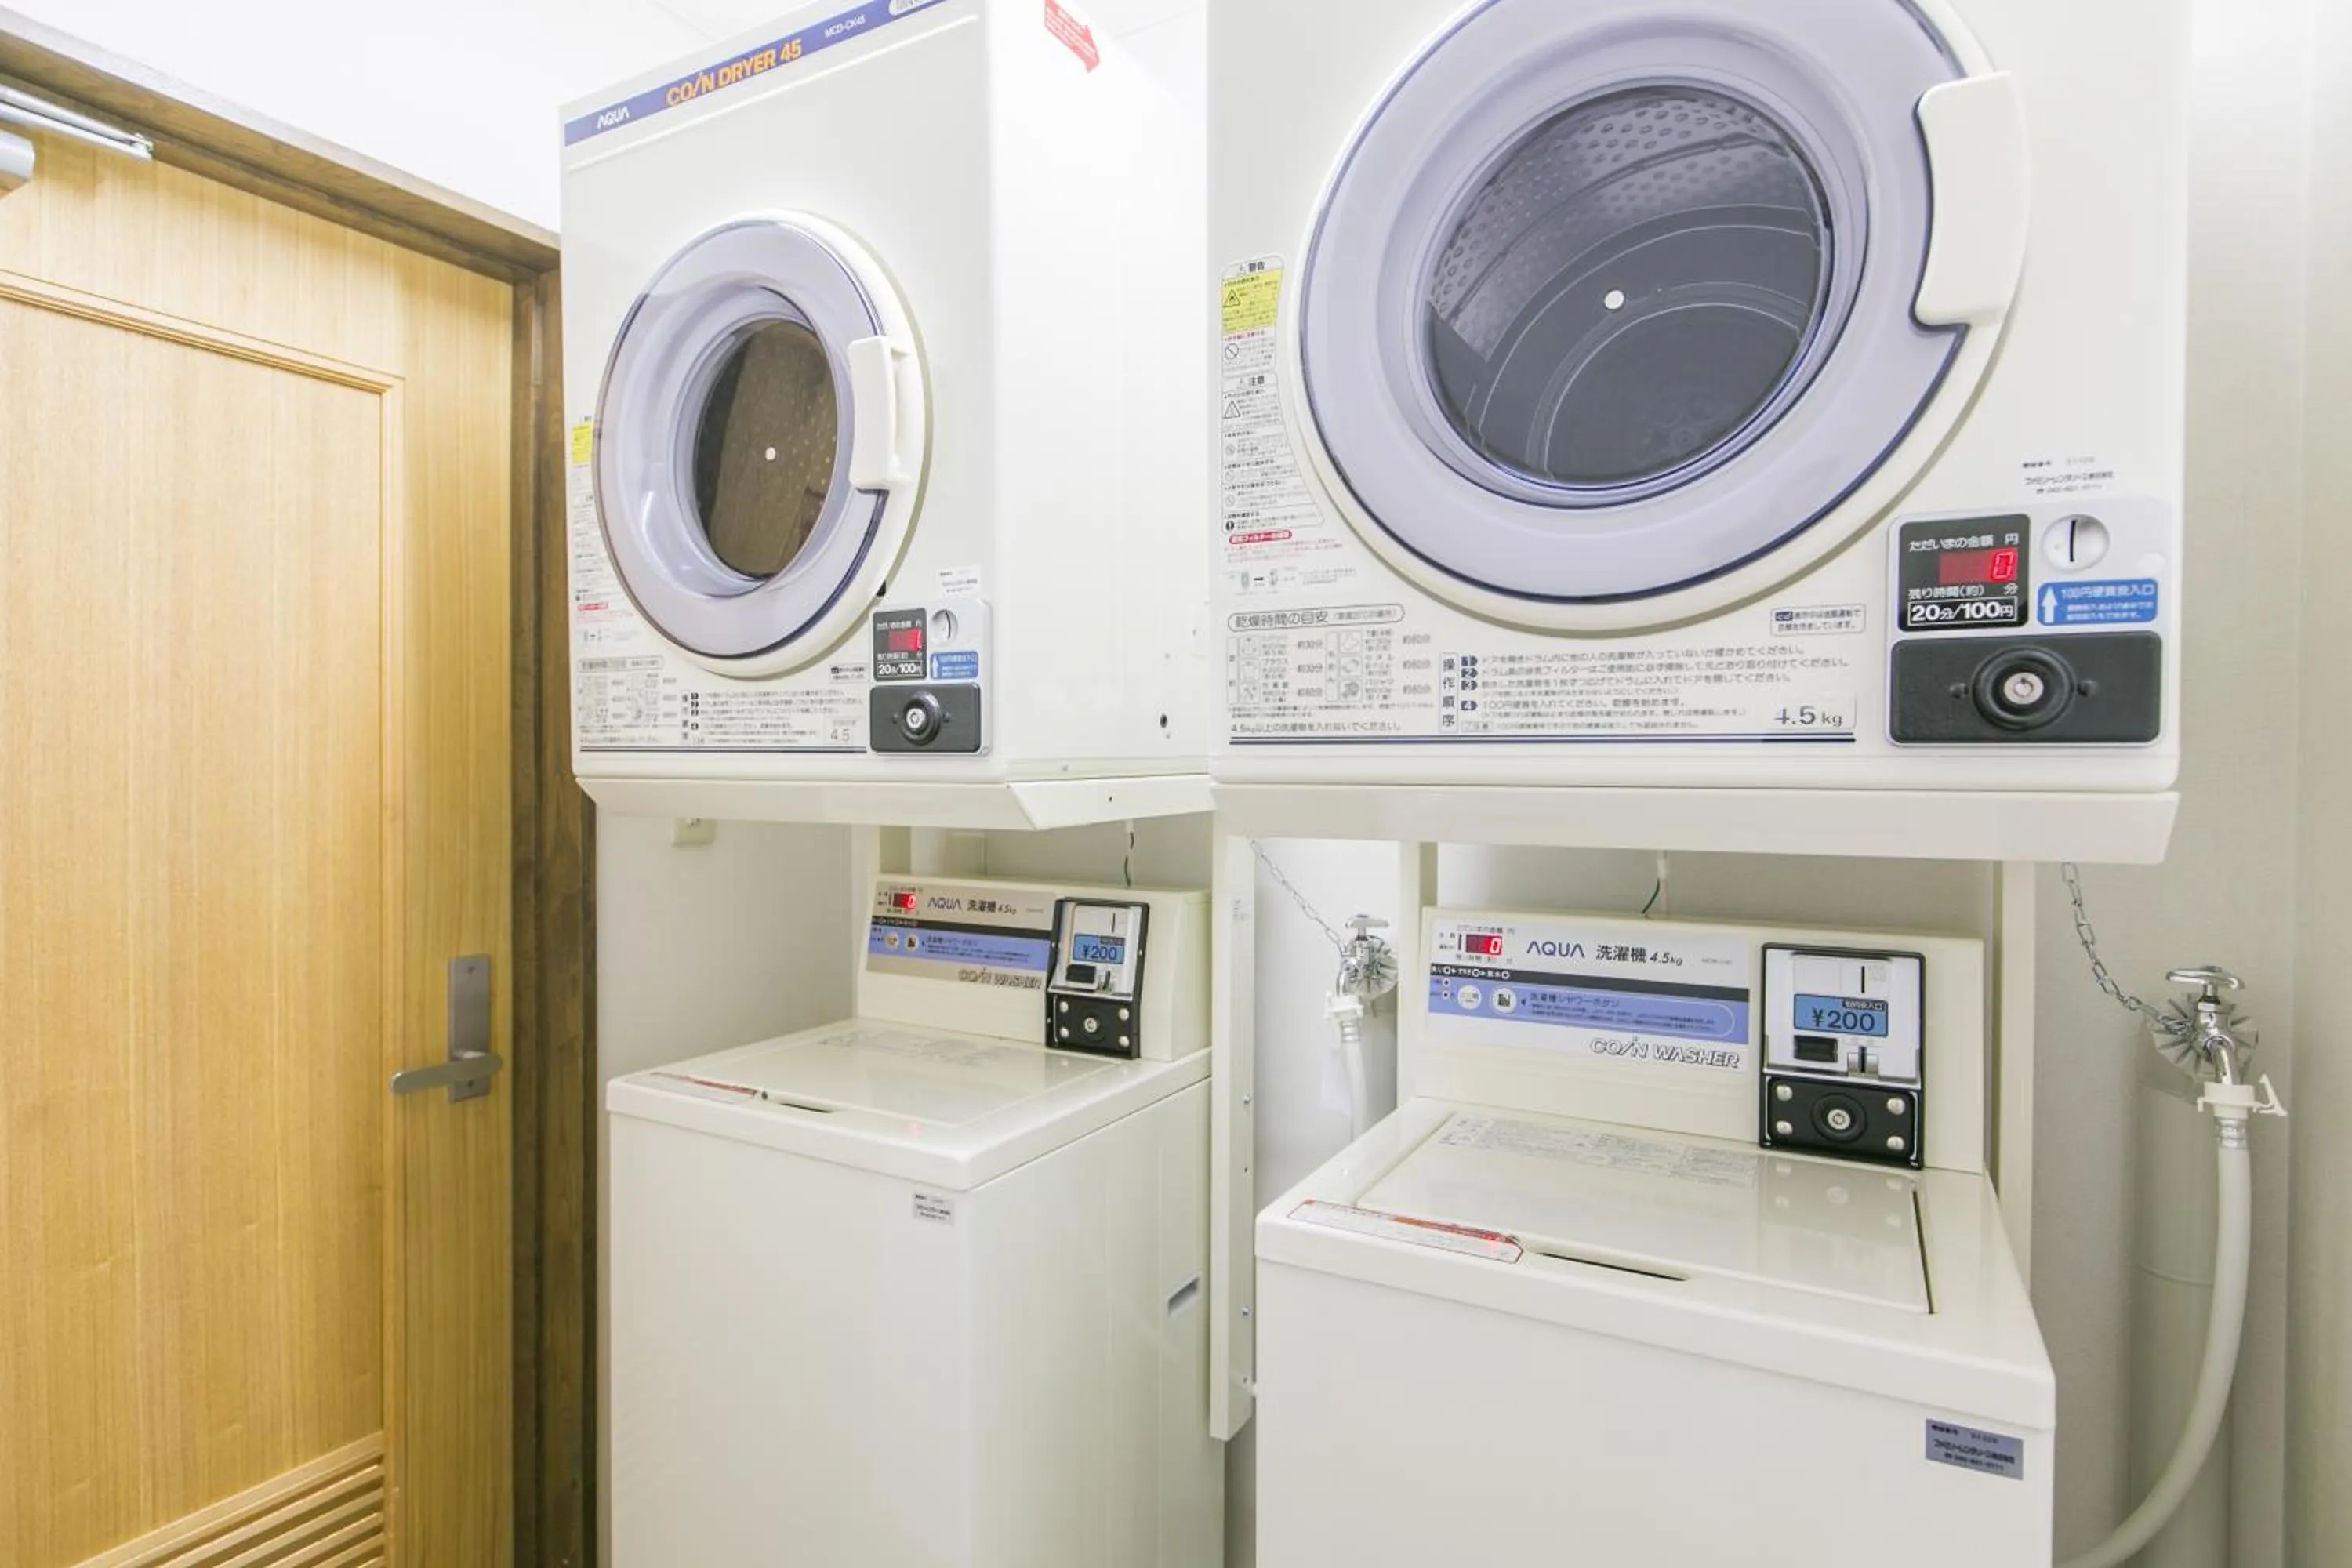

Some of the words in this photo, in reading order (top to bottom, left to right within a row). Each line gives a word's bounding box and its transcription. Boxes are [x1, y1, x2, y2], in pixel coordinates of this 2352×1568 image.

[597, 106, 630, 129] AQUA
[719, 49, 776, 88] DRYER
[781, 39, 802, 62] 45
[1909, 535, 1994, 552] ただいまの金額
[2005, 533, 2020, 546] 円
[1993, 551, 2014, 580] 0
[2004, 583, 2019, 597] 分
[1911, 601, 2015, 622] 20分/100円
[1774, 706, 1816, 726] 4.5
[1821, 713, 1843, 728] kg
[927, 897, 962, 912] AQUA
[1081, 944, 1117, 961] ¥200
[1490, 937, 1501, 953] 0
[1526, 940, 1585, 960] AQUA
[1595, 944, 1647, 964] 洗濯機
[1650, 953, 1683, 966] 4.5kg
[1812, 1008, 1875, 1033] ¥200
[1653, 1045, 1740, 1068] WASHER
